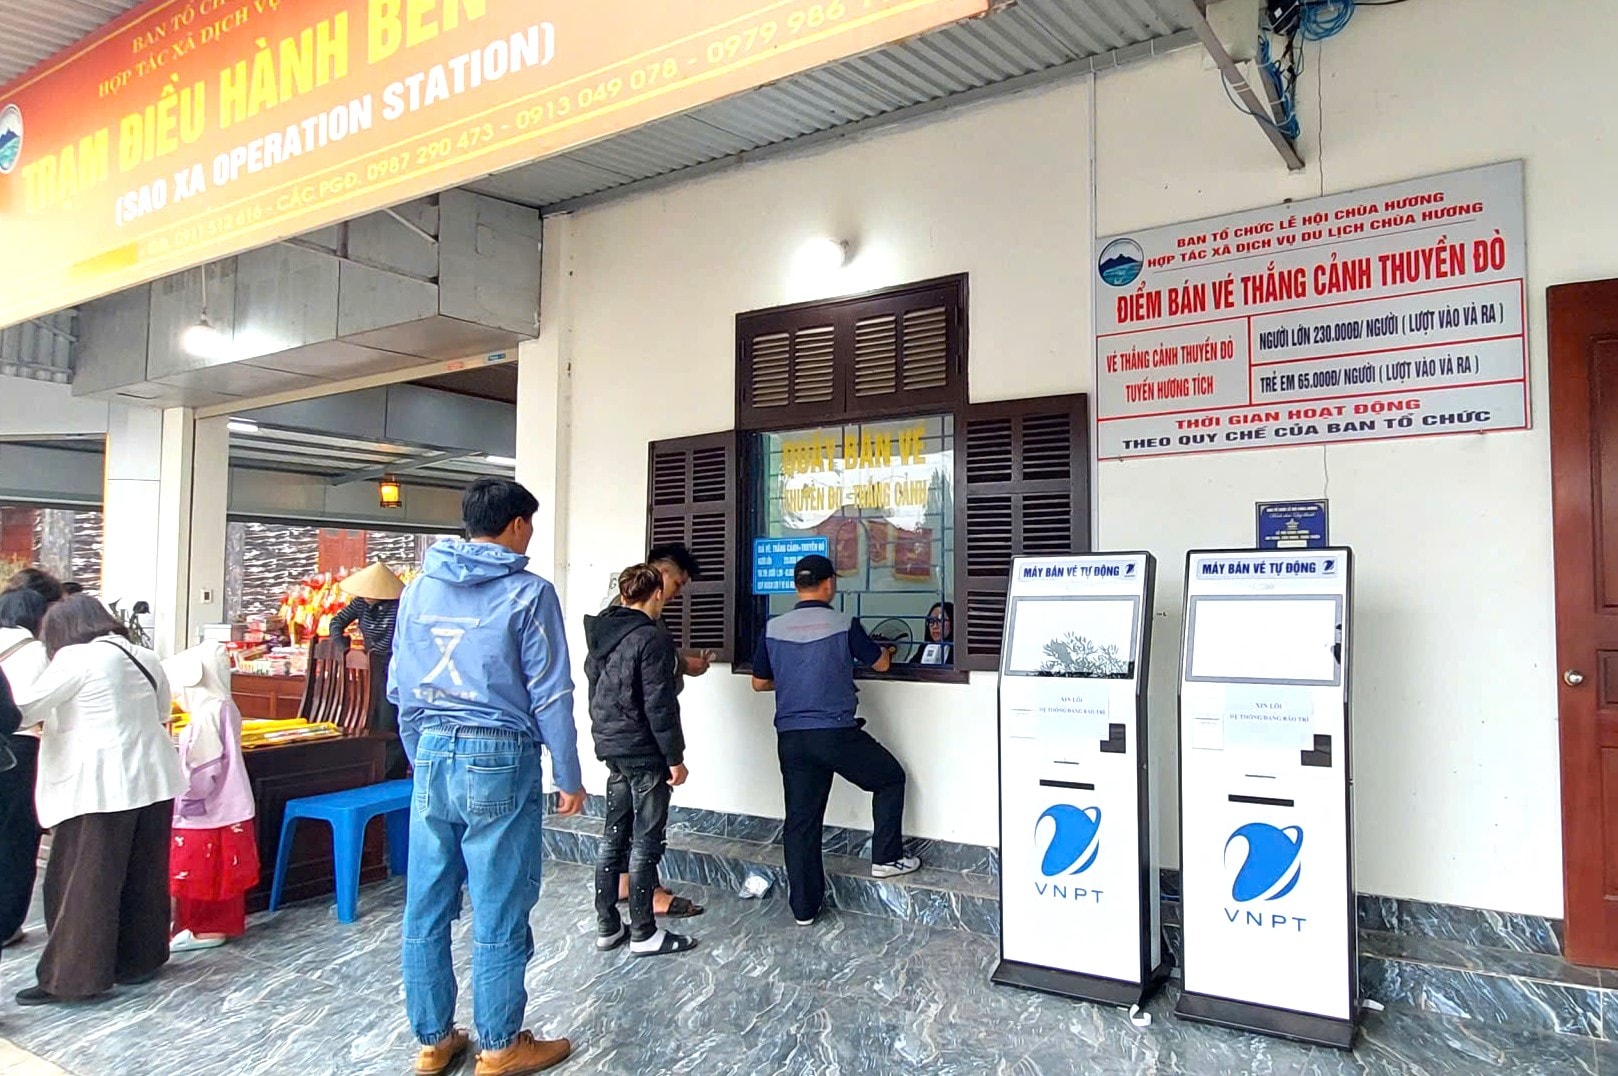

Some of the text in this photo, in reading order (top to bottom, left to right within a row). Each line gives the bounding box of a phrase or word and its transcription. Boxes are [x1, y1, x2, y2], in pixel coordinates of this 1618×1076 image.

[98, 69, 132, 98] HỢP
[136, 49, 169, 77] TÁC
[201, 6, 249, 44] DỊCH
[132, 23, 166, 53] BAN
[21, 127, 109, 213] TRẠM
[118, 72, 206, 174] ĐIỀU
[218, 10, 349, 130] HÀNH
[115, 22, 555, 229] (SAO XA OPERATION STATION)
[276, 184, 316, 211] CÁC
[367, 155, 410, 181] 0987
[415, 137, 451, 165] 290
[456, 125, 494, 151] 473
[515, 96, 571, 130] 0913
[577, 77, 622, 109] 049
[627, 57, 679, 88] 078
[706, 20, 777, 64] 0979
[786, 3, 845, 34] 986
[1147, 202, 1483, 269] HỢP TÁC XÃ DỊCH VỤ DU LỊCH CHÙA HƯƠNG
[1177, 234, 1207, 248] BAN
[1234, 222, 1274, 238] CHỨC
[1302, 212, 1328, 226] HỘI
[1334, 204, 1379, 221] CHÙA
[1384, 192, 1444, 212] HƯƠNG
[1116, 228, 1506, 324] ĐIỂM BÁN VÉ THẮNG CẢNH THUYỀN ĐÒ
[1259, 325, 1289, 351] NGƯỜI
[1291, 322, 1311, 347] LỚN
[1313, 318, 1364, 344] 230.000Đ/
[1366, 312, 1399, 338] NGƯỜI
[1409, 309, 1435, 336] LƯỢT
[1438, 305, 1460, 329] VÀO
[1462, 301, 1478, 326] VÀ
[1481, 303, 1496, 324] RA
[1106, 335, 1234, 374] VÉ THẮNG CẢNH THUYỀN ĐÒ
[1260, 370, 1278, 394] TRẺ
[1280, 373, 1296, 392] EM
[1298, 368, 1342, 391] 65.000Đ/
[1344, 361, 1376, 386] NGƯỜI
[1386, 361, 1412, 384] LƯỢT
[1414, 356, 1436, 379] VÀO
[1439, 353, 1453, 376] VÀ
[1457, 356, 1472, 374] RA
[1125, 373, 1214, 403] TUYẾN HƯƠNG TÍCH
[1122, 437, 1171, 450] THEO
[1178, 433, 1218, 446] QUY
[1225, 425, 1268, 442] CHẾ
[1274, 422, 1319, 436] CỦA
[1327, 420, 1375, 434] BAN
[1422, 410, 1491, 427] CHỨC
[1176, 399, 1421, 430] THỜI GIAN HOẠT ĐỘNG
[899, 419, 926, 465] VÉ
[1023, 564, 1120, 579] MÁY BÁN VÉ TỰ ĐỘNG
[1202, 560, 1316, 576] MÁY BÁN VÉ TỰ ĐỘNG
[1034, 882, 1104, 904] VNPT
[1224, 908, 1307, 932] VNPT
